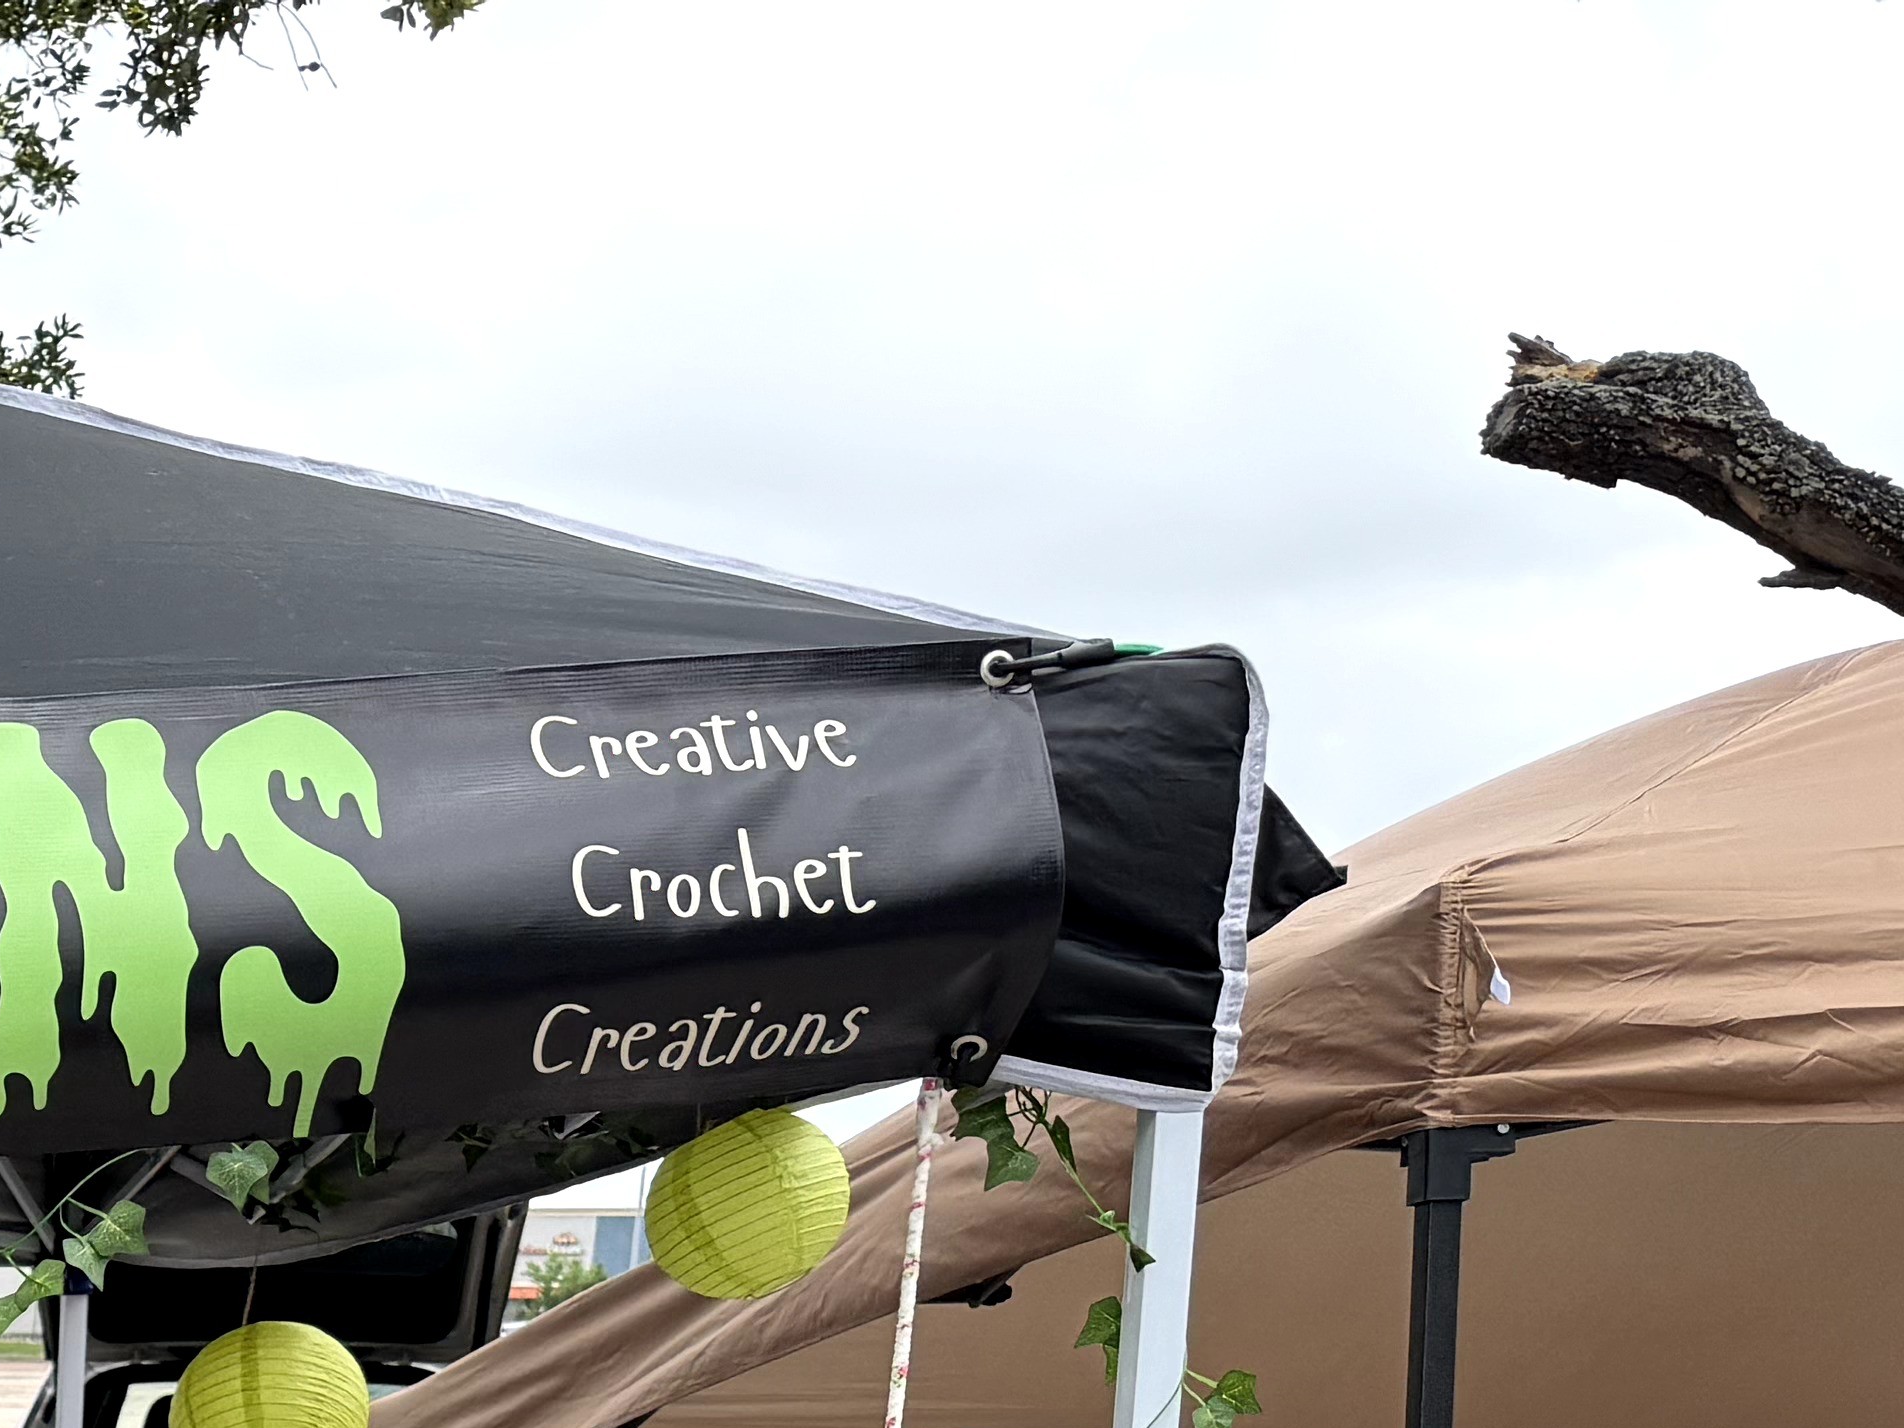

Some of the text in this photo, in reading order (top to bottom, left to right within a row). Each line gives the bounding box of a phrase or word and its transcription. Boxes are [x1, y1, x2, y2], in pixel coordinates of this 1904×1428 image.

[529, 709, 857, 779] Creative
[571, 827, 877, 921] Crochet
[532, 1001, 870, 1075] Creations
